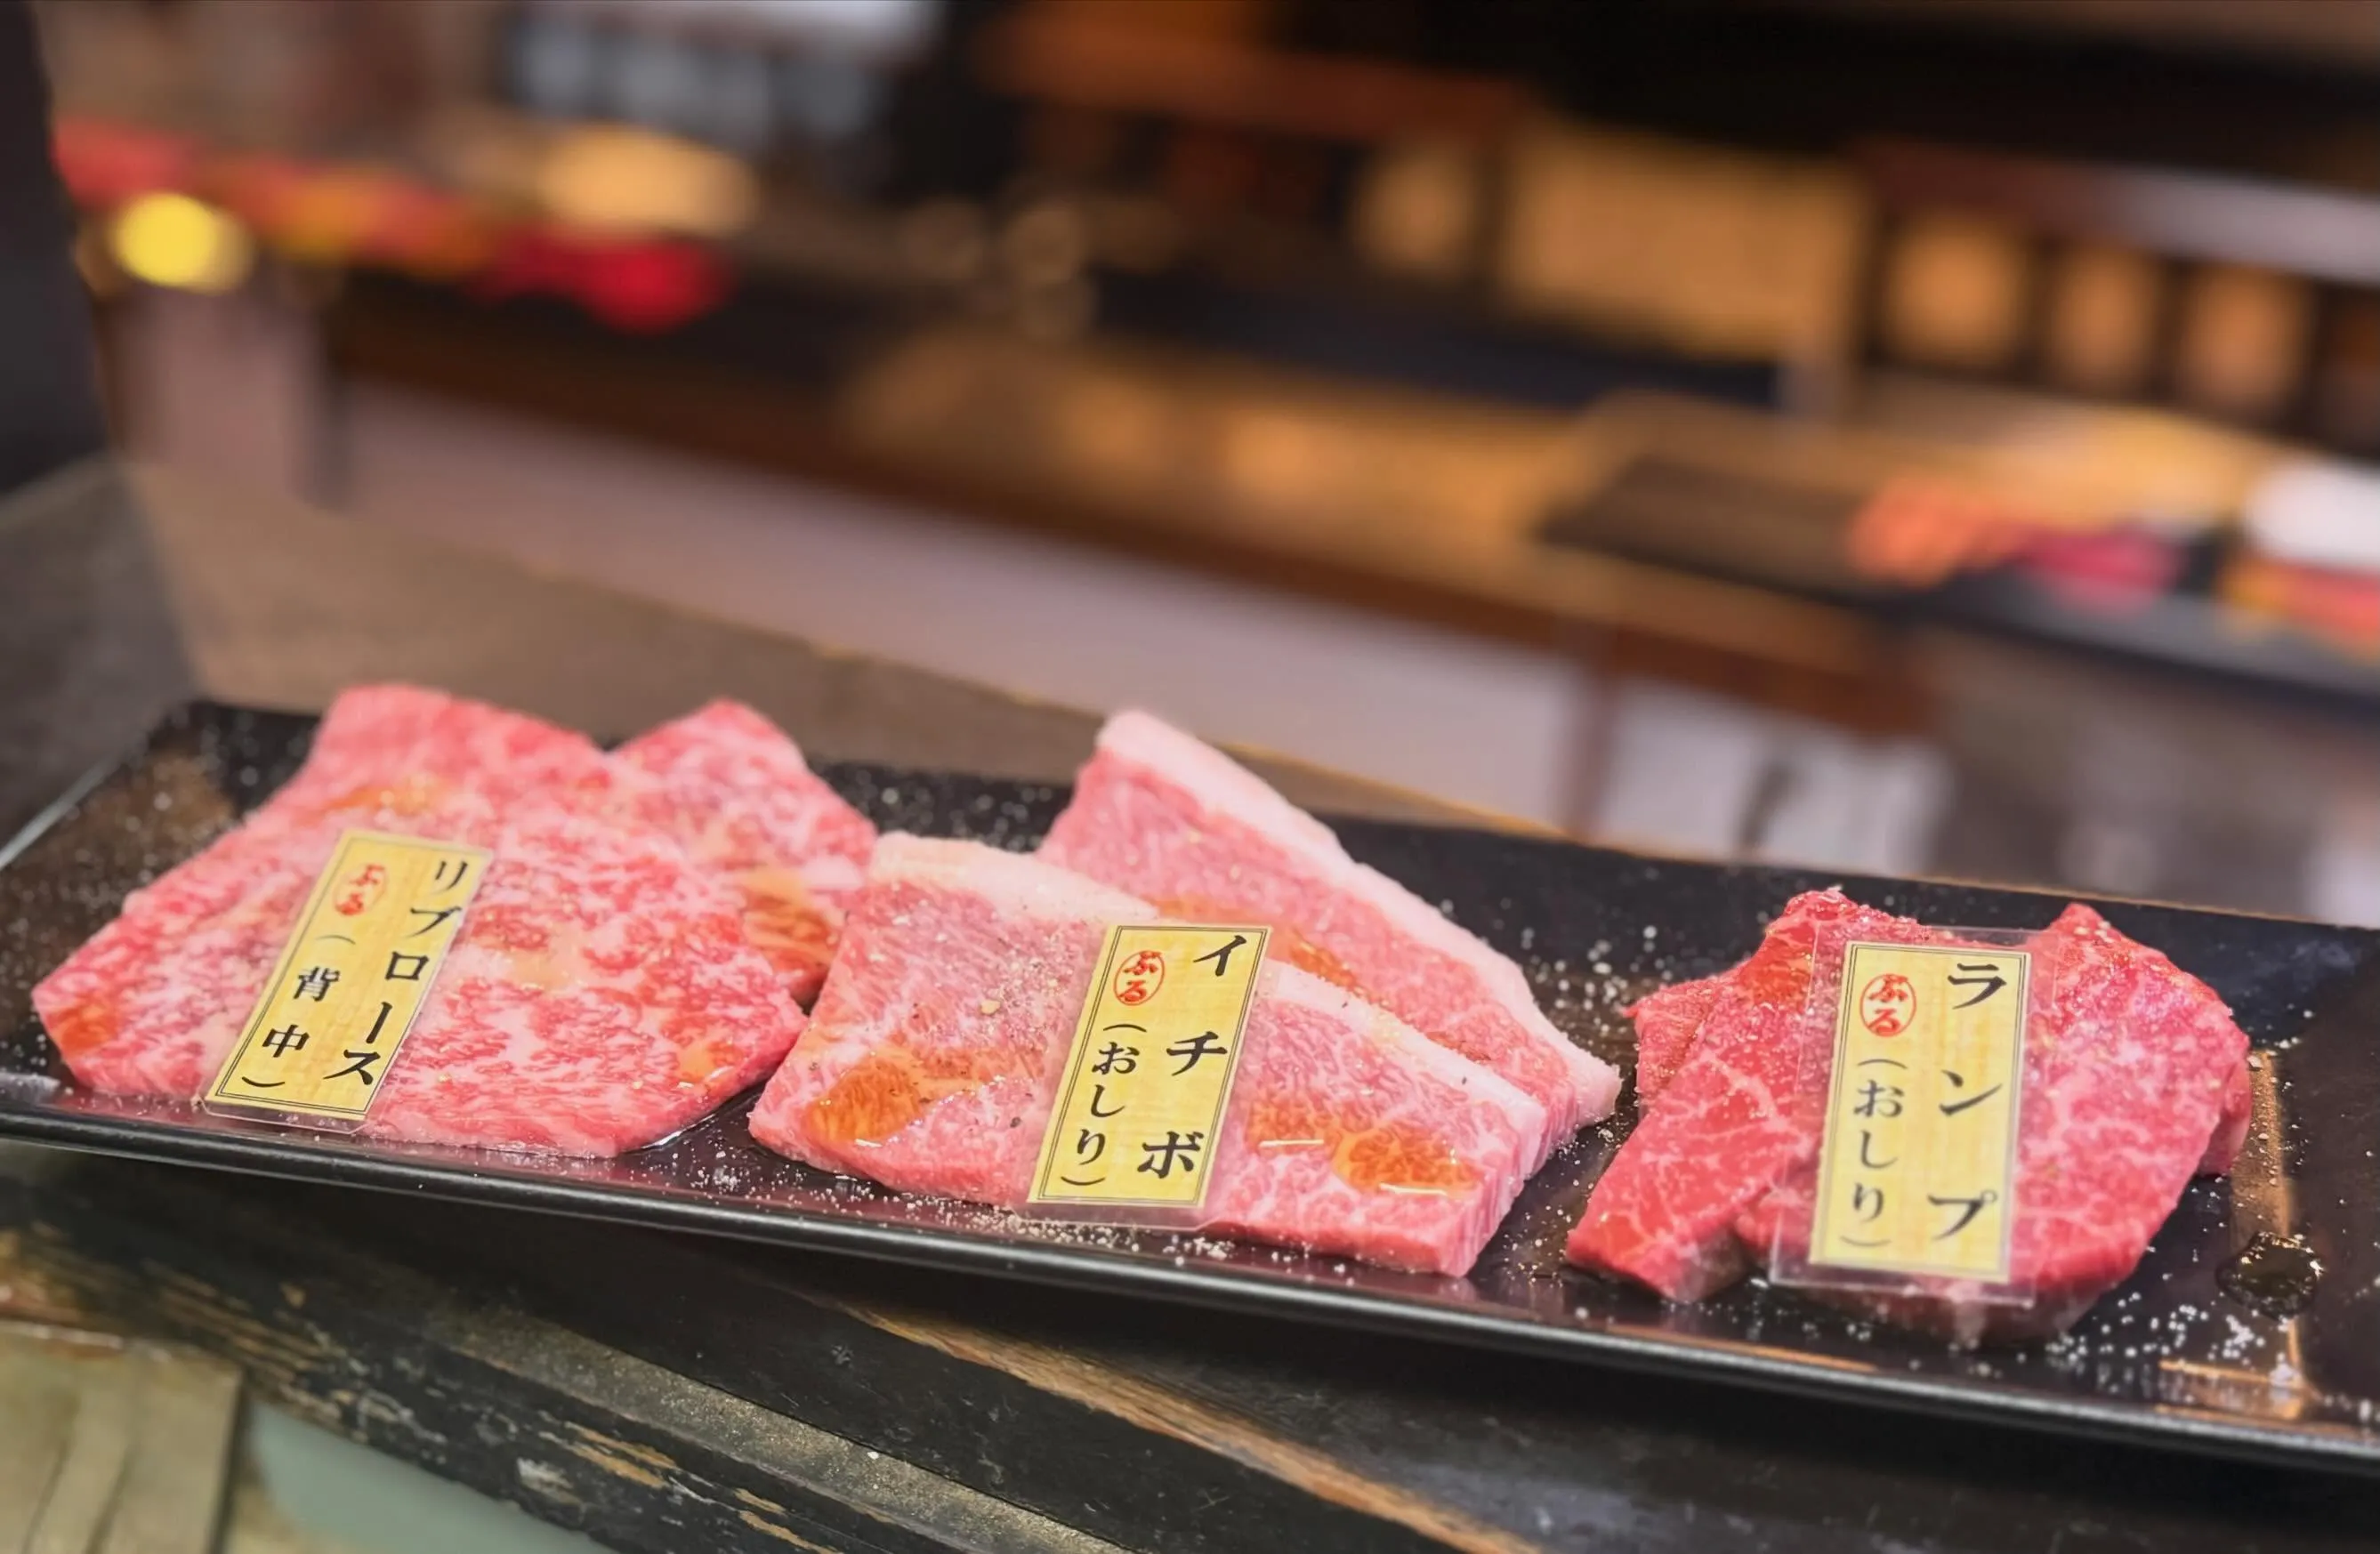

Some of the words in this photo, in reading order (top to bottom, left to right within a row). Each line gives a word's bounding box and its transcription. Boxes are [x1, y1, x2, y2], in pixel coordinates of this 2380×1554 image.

[1137, 935, 1247, 1179] イチボ
[1926, 962, 2008, 1241] ランプ
